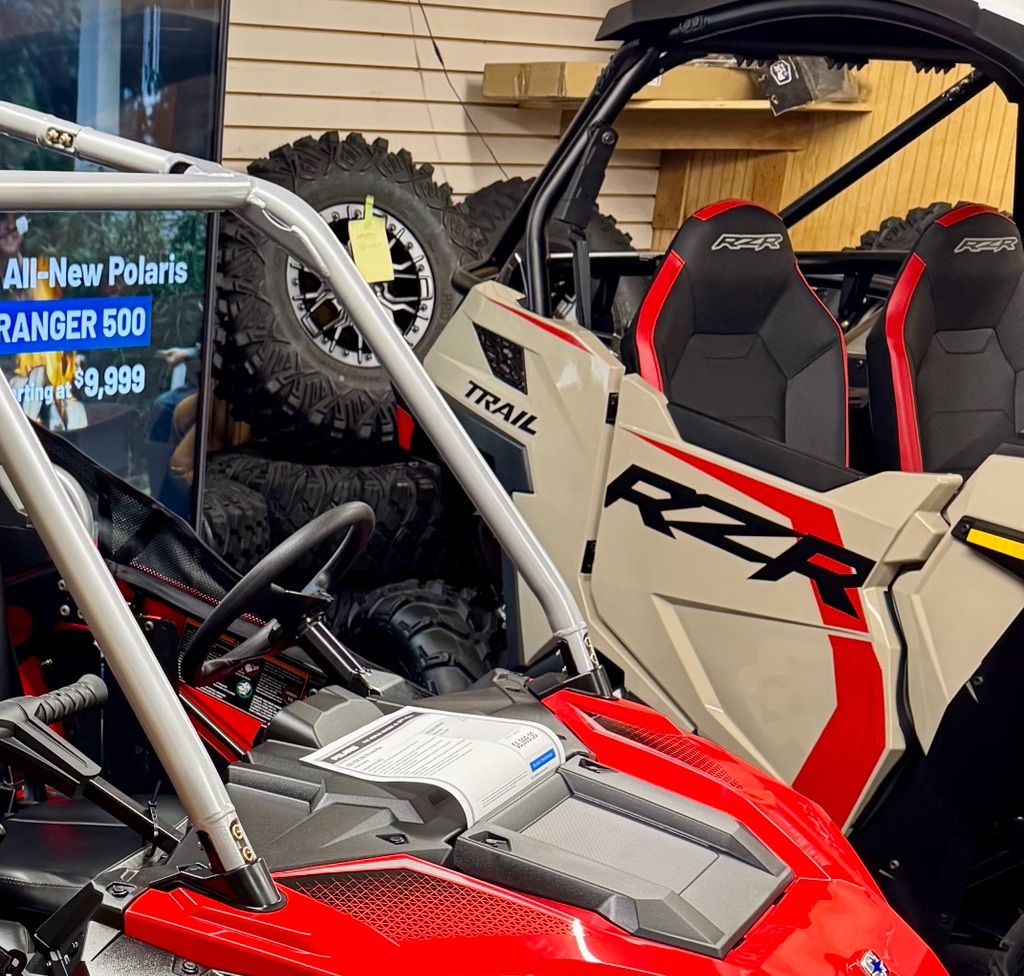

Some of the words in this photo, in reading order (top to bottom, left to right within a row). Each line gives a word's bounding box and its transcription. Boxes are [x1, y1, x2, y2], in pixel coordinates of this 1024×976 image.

[711, 233, 783, 252] RZR
[953, 236, 1018, 255] RZR
[3, 256, 103, 290] All-New
[108, 253, 188, 286] Polaris
[103, 307, 146, 338] 500
[56, 382, 72, 400] at
[74, 363, 145, 400] $9,999
[465, 380, 538, 436] TRAIL
[604, 463, 877, 620] RZR
